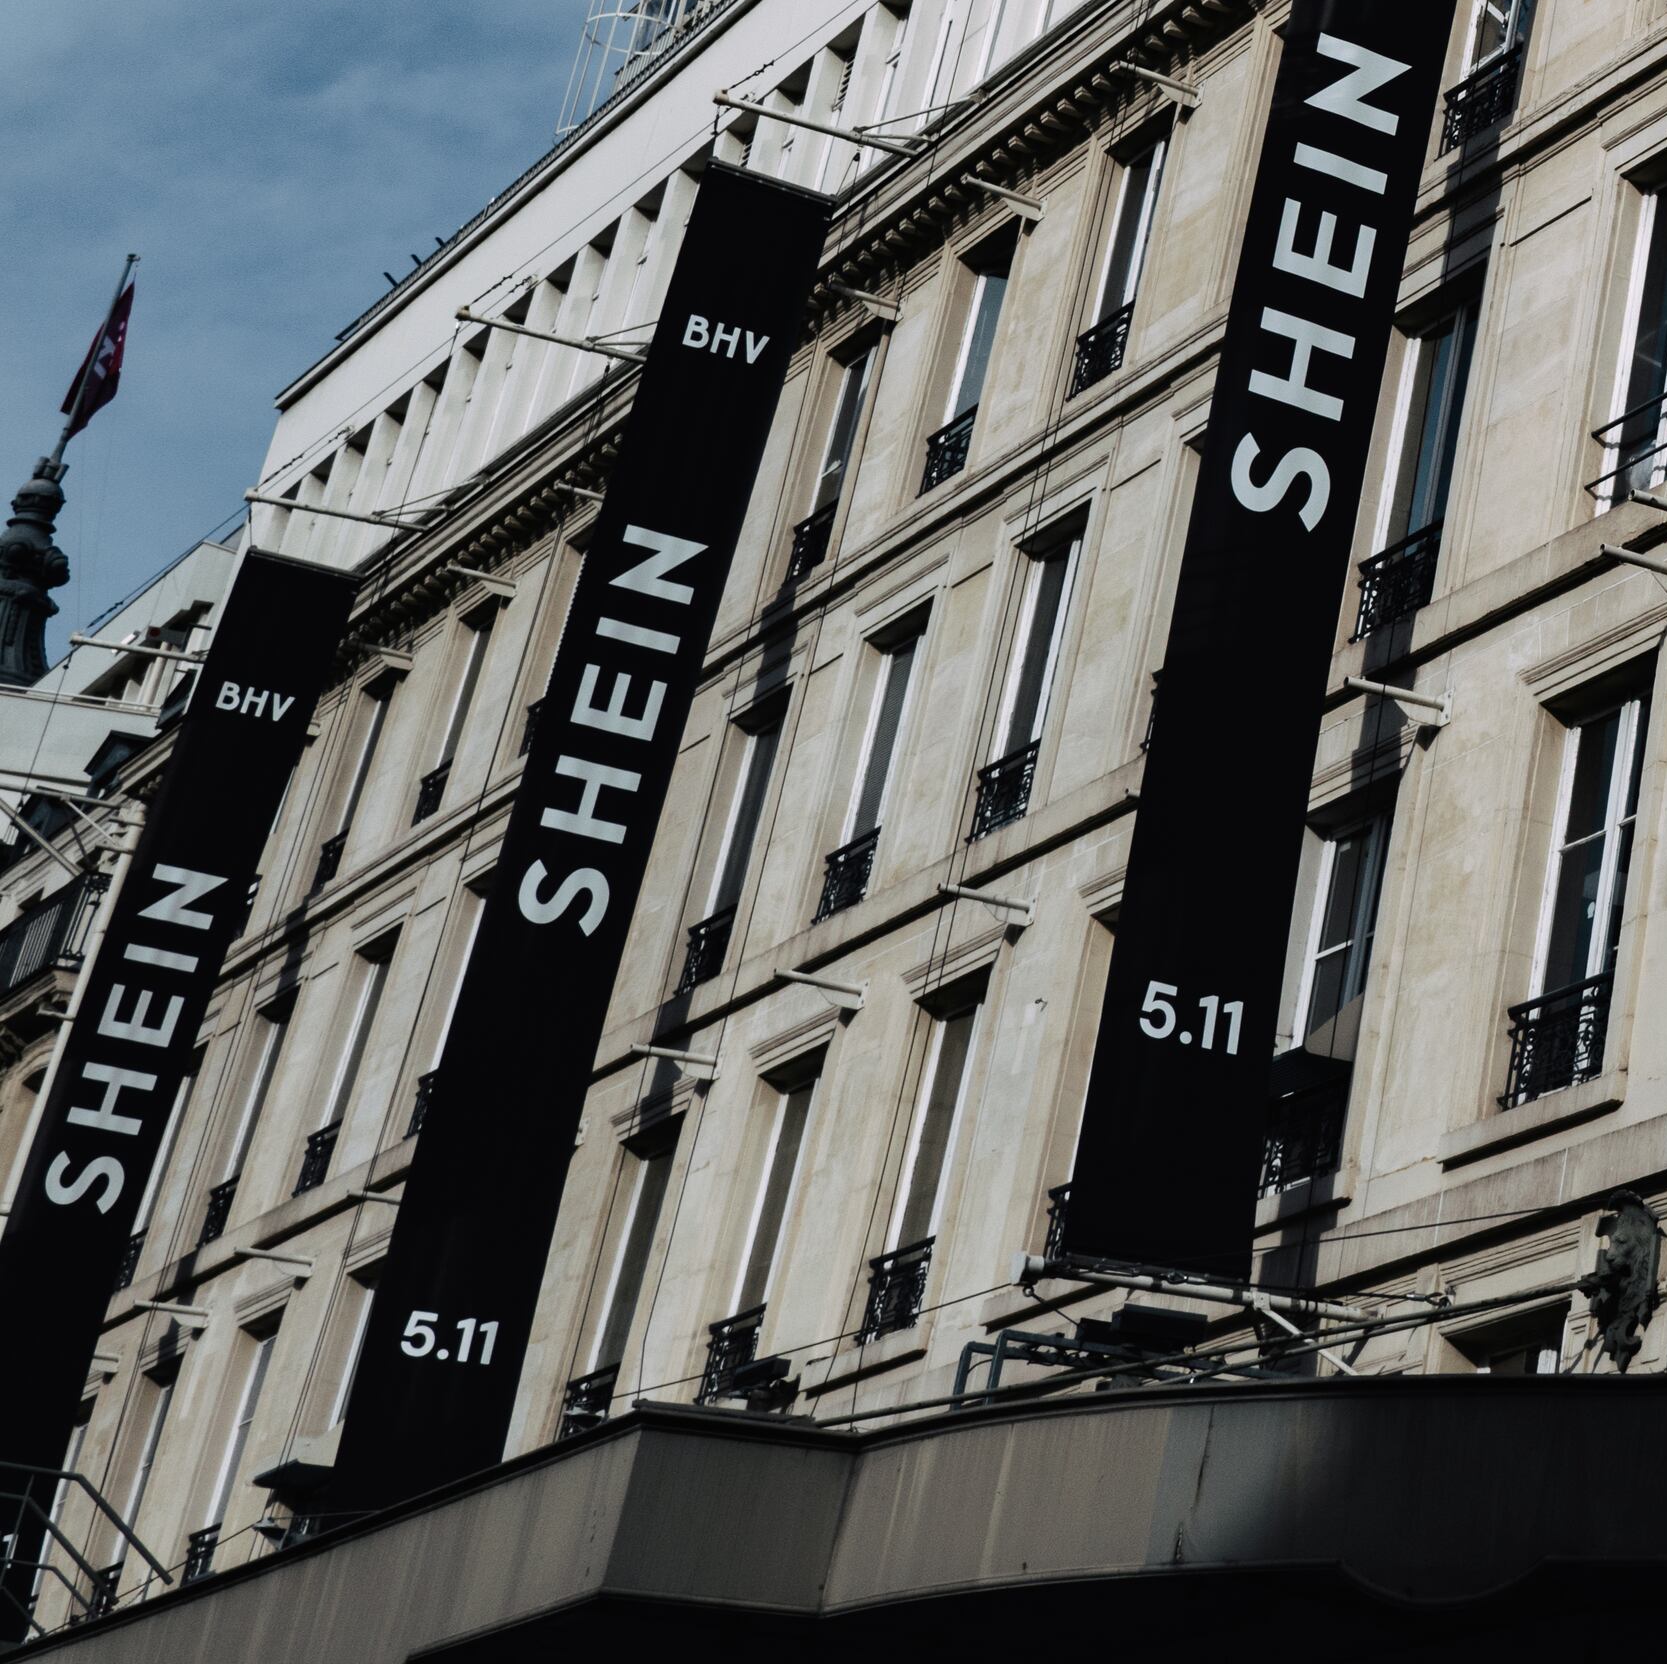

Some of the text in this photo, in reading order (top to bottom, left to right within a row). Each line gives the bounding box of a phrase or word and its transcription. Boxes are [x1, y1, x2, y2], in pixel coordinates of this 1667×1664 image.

[1230, 31, 1413, 532] SHEIN
[682, 314, 771, 364] BHV
[215, 681, 296, 722] BHV
[518, 524, 708, 938] SHEIN
[45, 863, 229, 1214] SHEIN
[1139, 980, 1245, 1056] 5.11
[400, 1310, 499, 1365] 5.11
